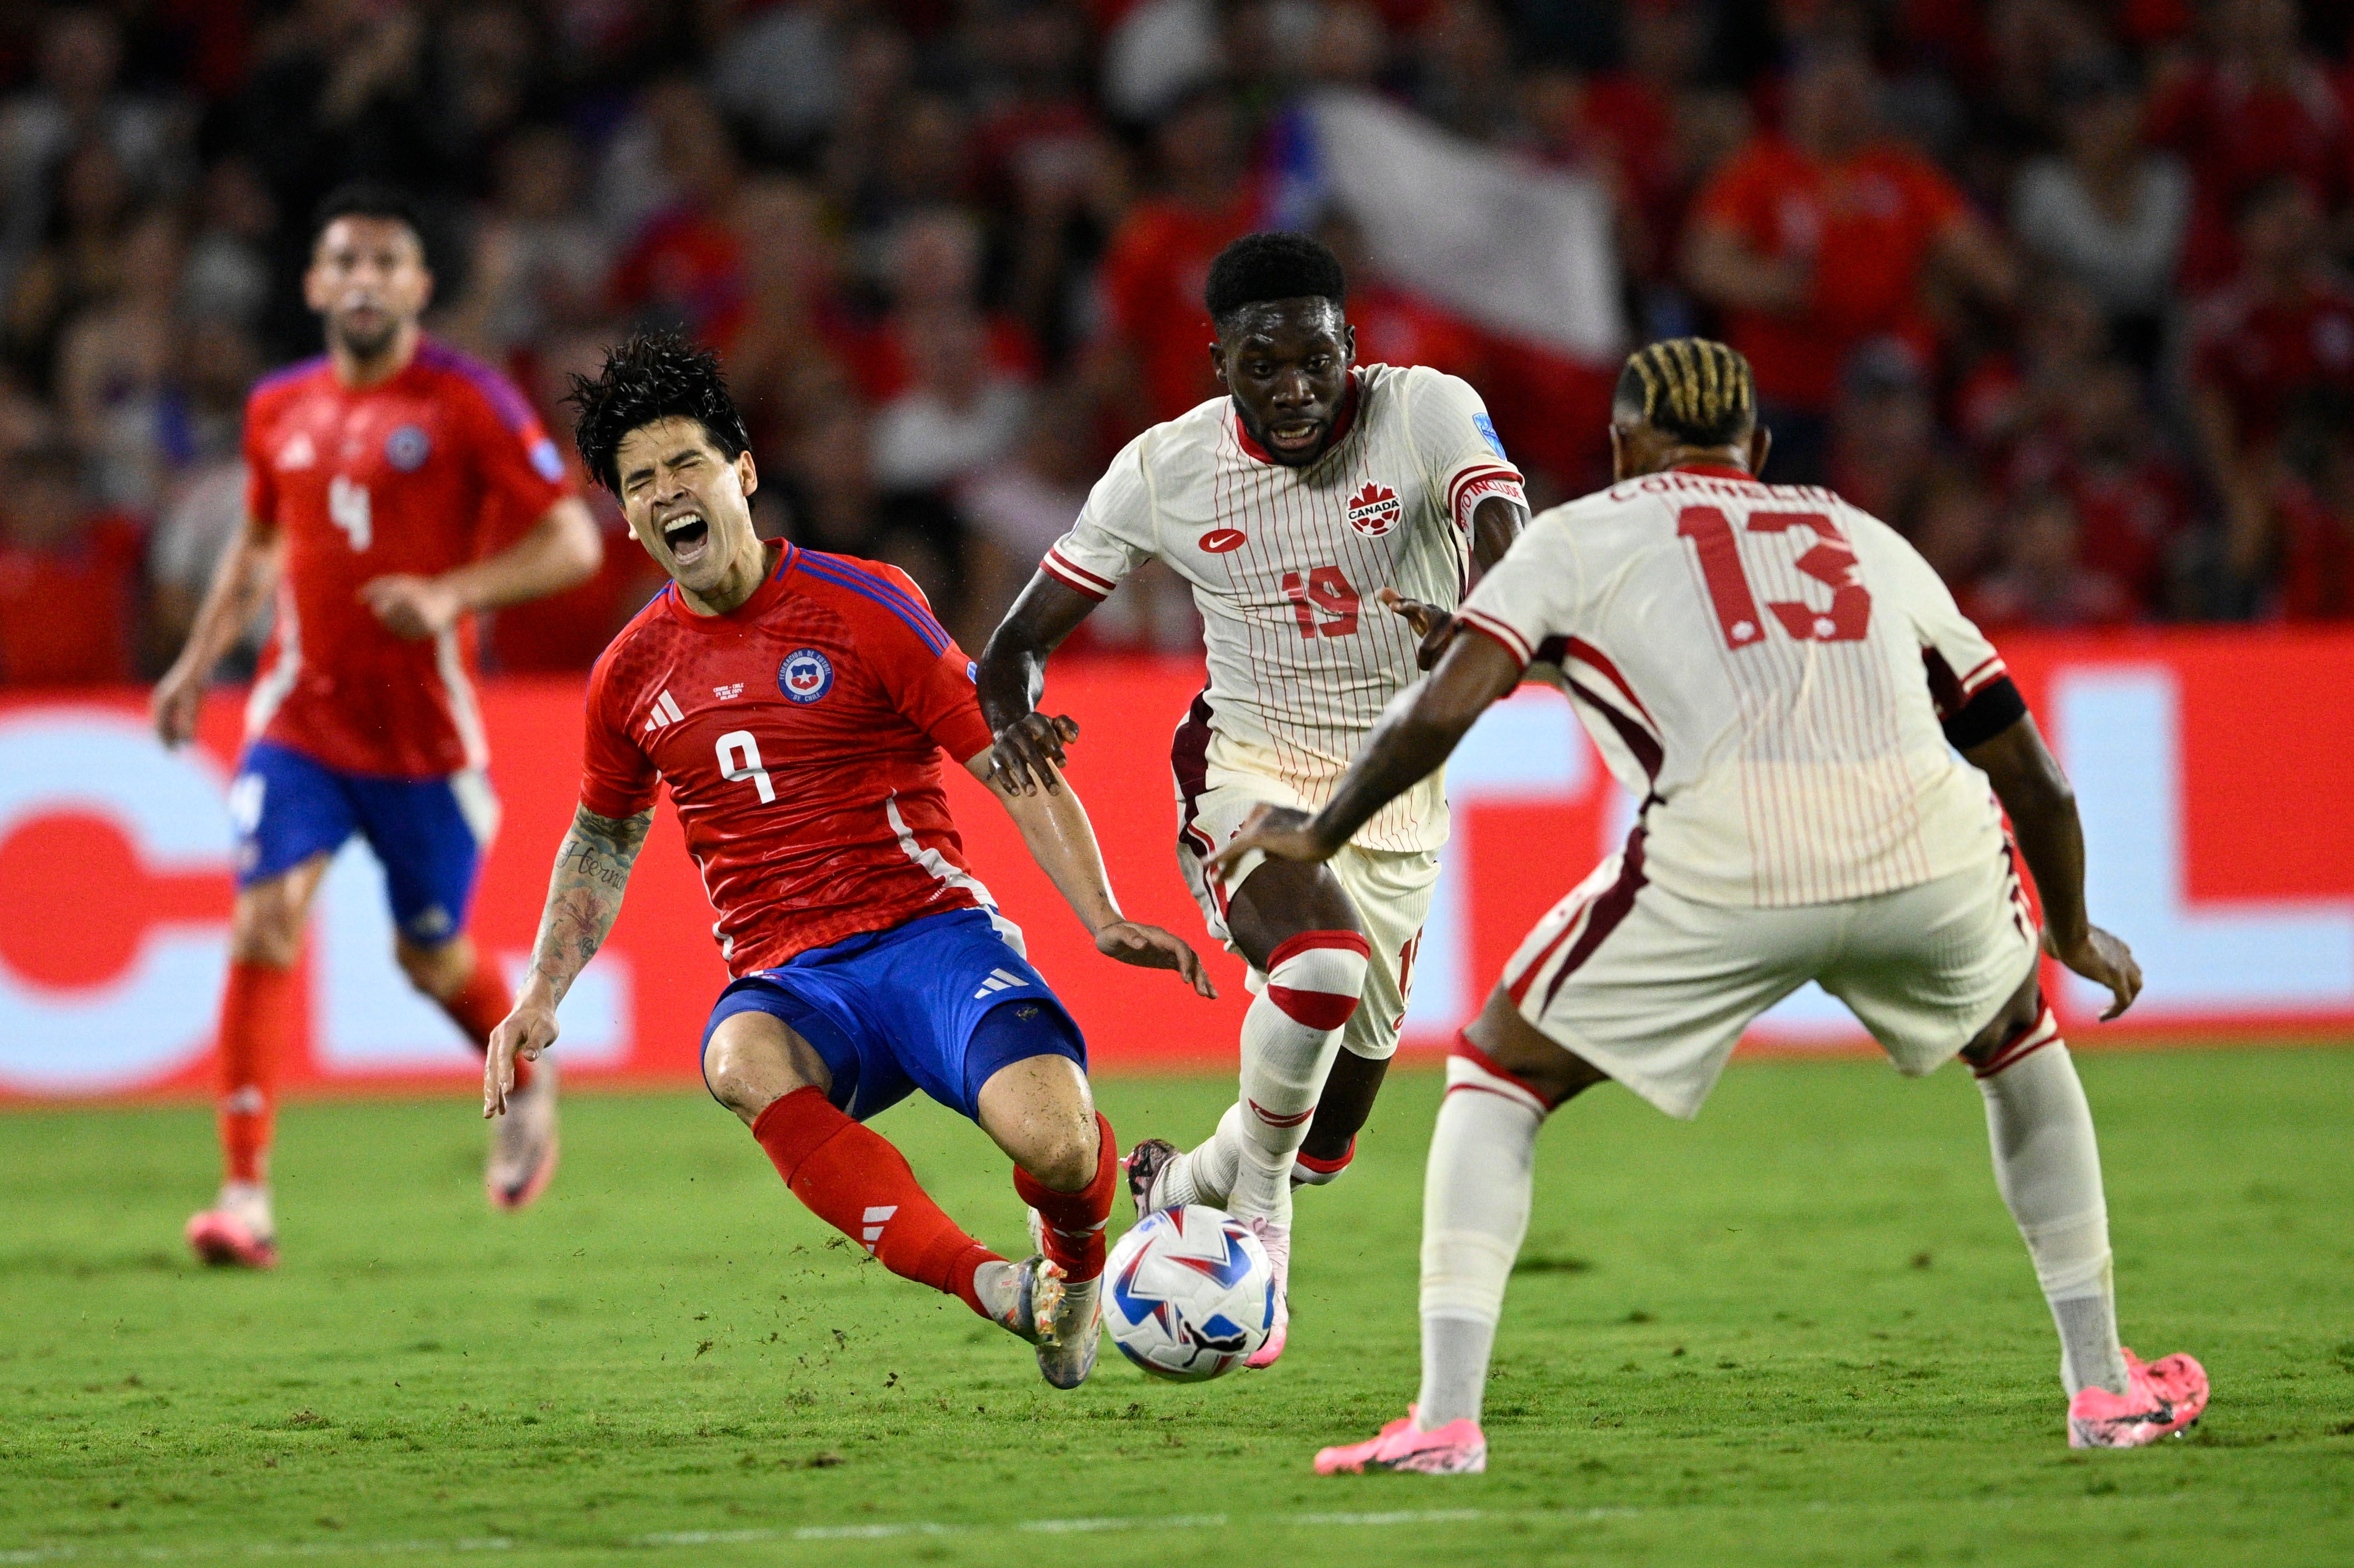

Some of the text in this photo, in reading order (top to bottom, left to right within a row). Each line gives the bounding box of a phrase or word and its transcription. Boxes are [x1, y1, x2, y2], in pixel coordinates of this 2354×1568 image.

[329, 475, 371, 552] 4
[1348, 500, 1399, 520] CANADA
[1470, 480, 1523, 500] INCLUDE
[1282, 566, 1359, 638] 19
[1676, 505, 1871, 651] 13
[715, 729, 776, 804] 9
[1398, 925, 1423, 1003] 1
